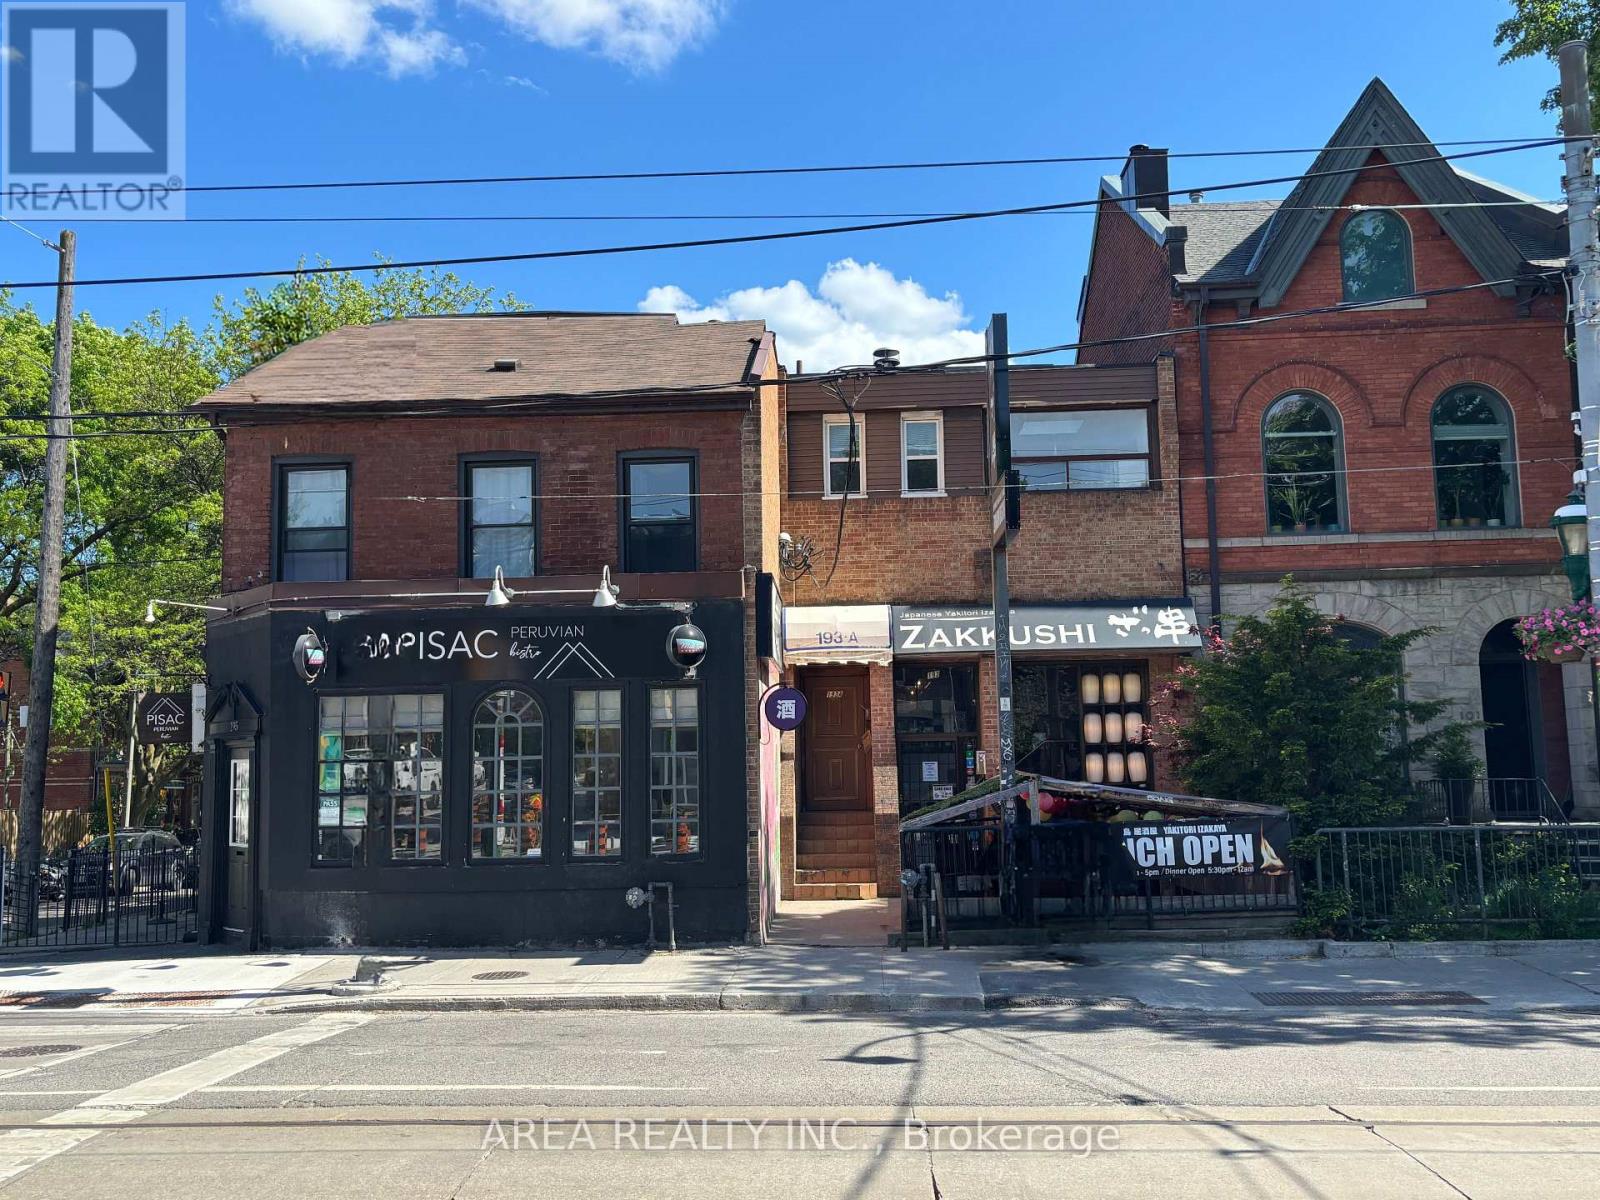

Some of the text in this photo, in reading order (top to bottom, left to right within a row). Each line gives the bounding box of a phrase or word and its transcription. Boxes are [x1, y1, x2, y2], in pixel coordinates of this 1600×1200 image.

[900, 611, 942, 619] Japanese
[511, 625, 584, 639] PERUVIAN
[509, 641, 542, 660] bistro
[776, 700, 796, 720] 酒
[146, 713, 185, 725] PISAC
[1163, 825, 1197, 834] YAKITORI
[1197, 824, 1227, 834] IZAKAYA
[1182, 833, 1255, 866] OPEN
[1188, 866, 1205, 875] Open
